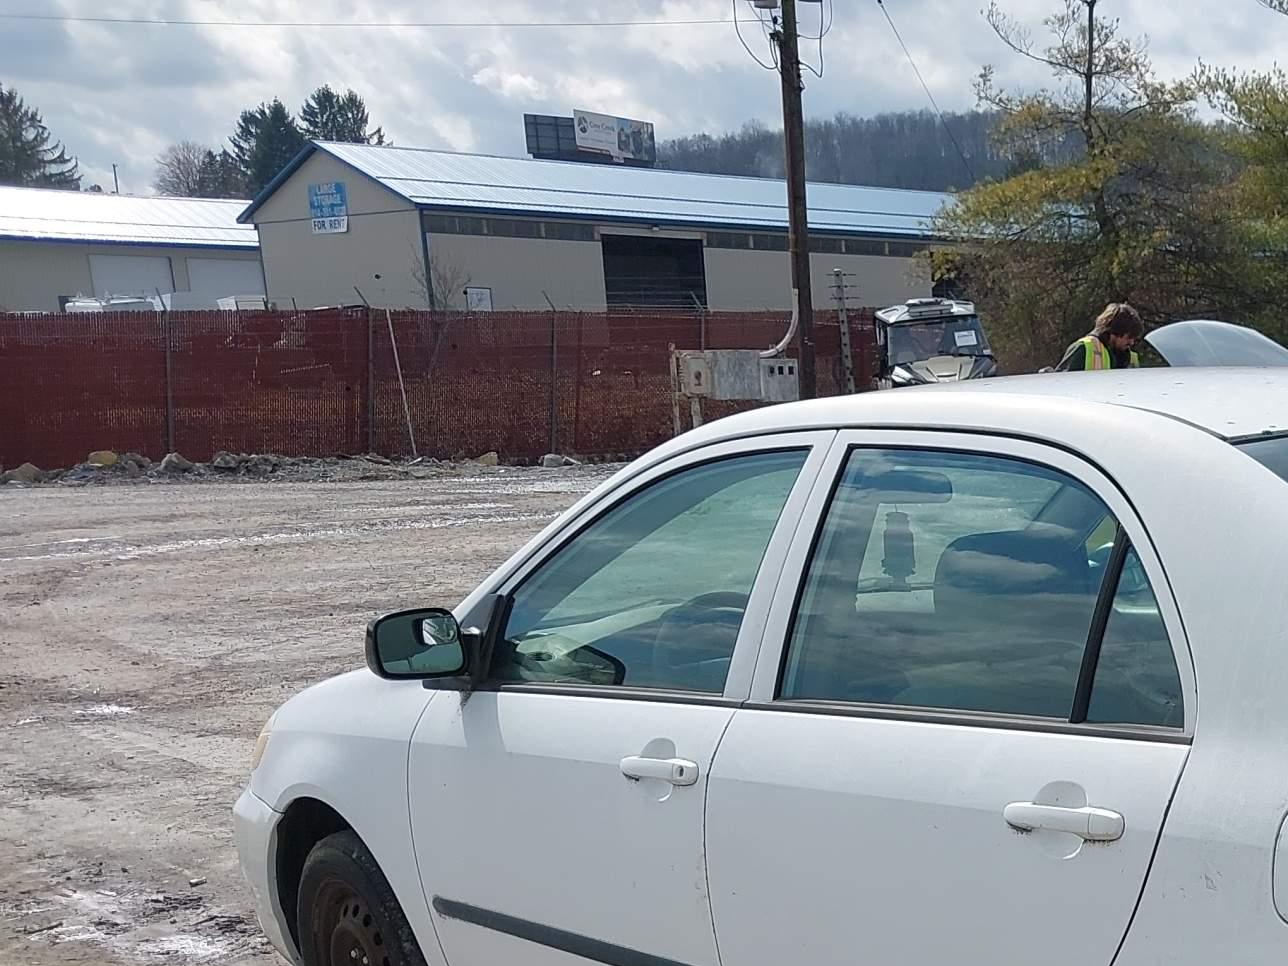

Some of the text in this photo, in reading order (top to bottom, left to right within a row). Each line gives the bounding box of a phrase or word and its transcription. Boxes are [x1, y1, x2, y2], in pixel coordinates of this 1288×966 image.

[315, 183, 336, 194] LARGE
[313, 194, 342, 207] STORAGE
[313, 218, 346, 231] FOR RENT
